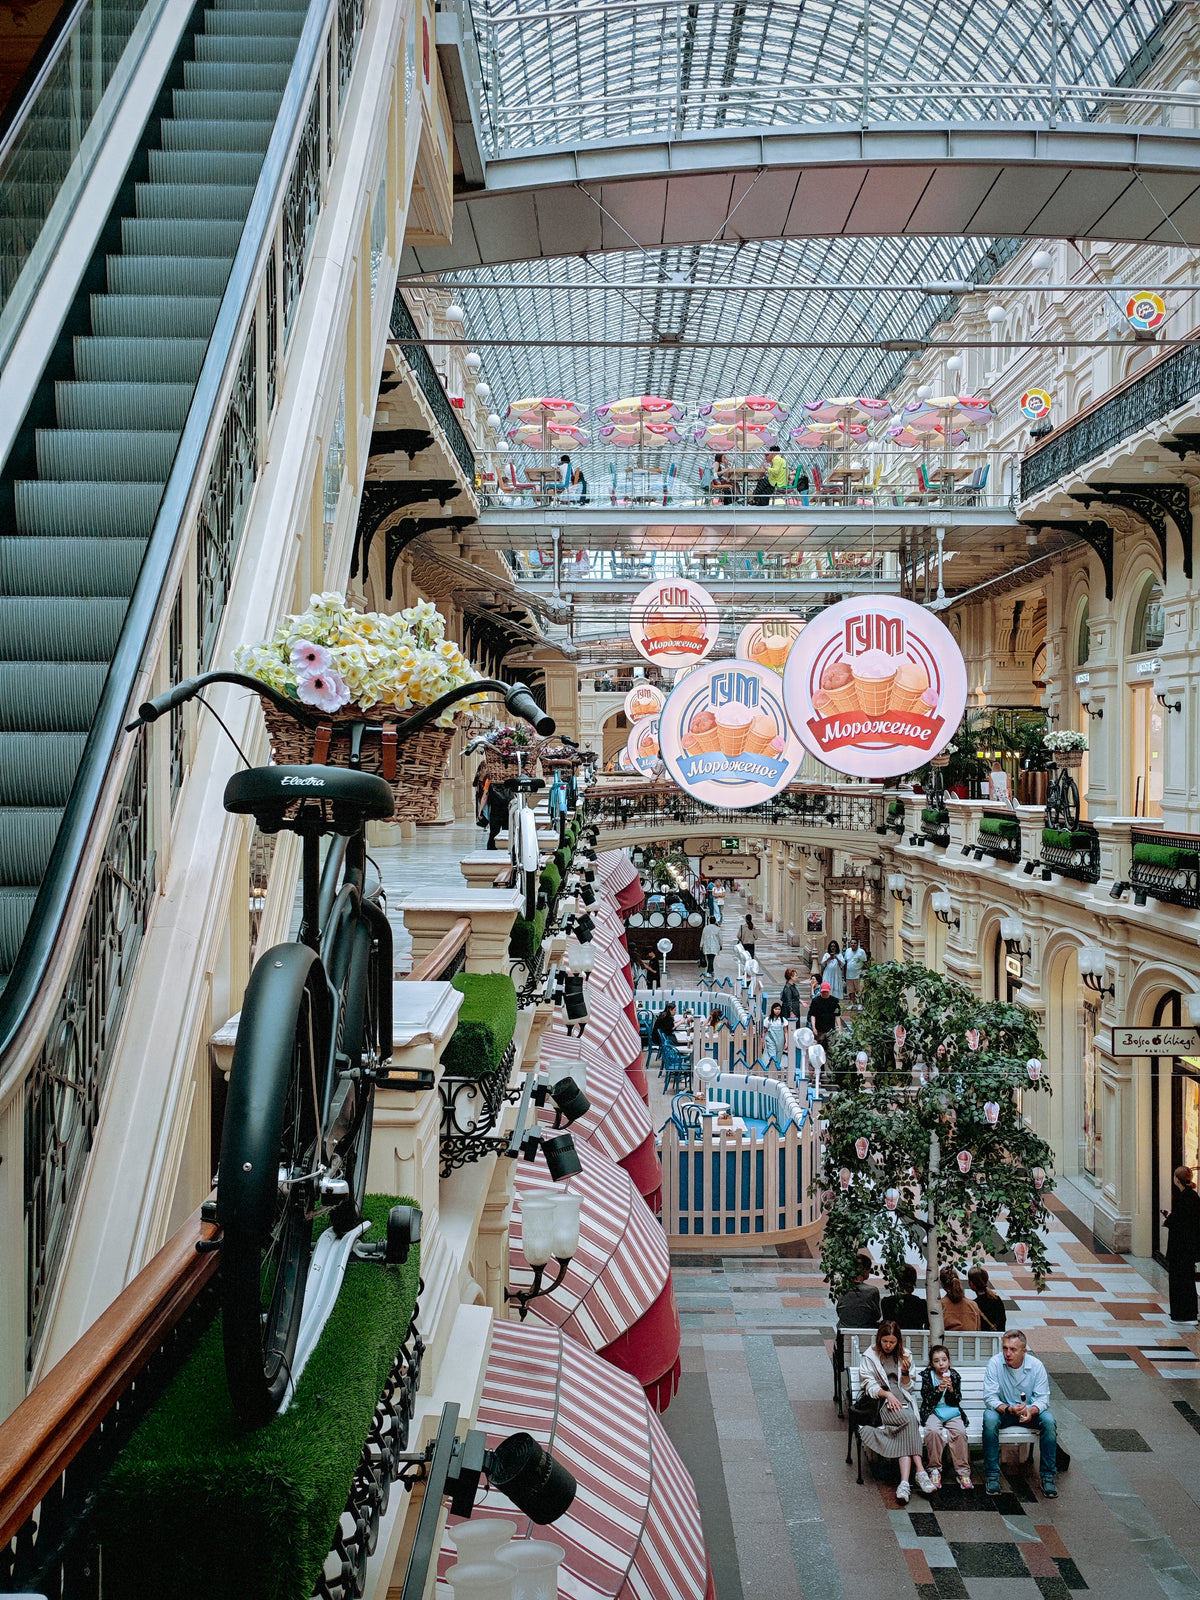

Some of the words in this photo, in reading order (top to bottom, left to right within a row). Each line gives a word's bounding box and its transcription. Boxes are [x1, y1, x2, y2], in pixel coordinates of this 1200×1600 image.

[660, 587, 689, 607] ГУМ
[845, 614, 904, 657] ГУМ
[648, 640, 703, 652] Мороженое
[711, 672, 760, 708] ГУМ
[821, 720, 932, 743] Мороженое
[687, 760, 778, 779] Мороженое
[281, 776, 326, 787] Electra
